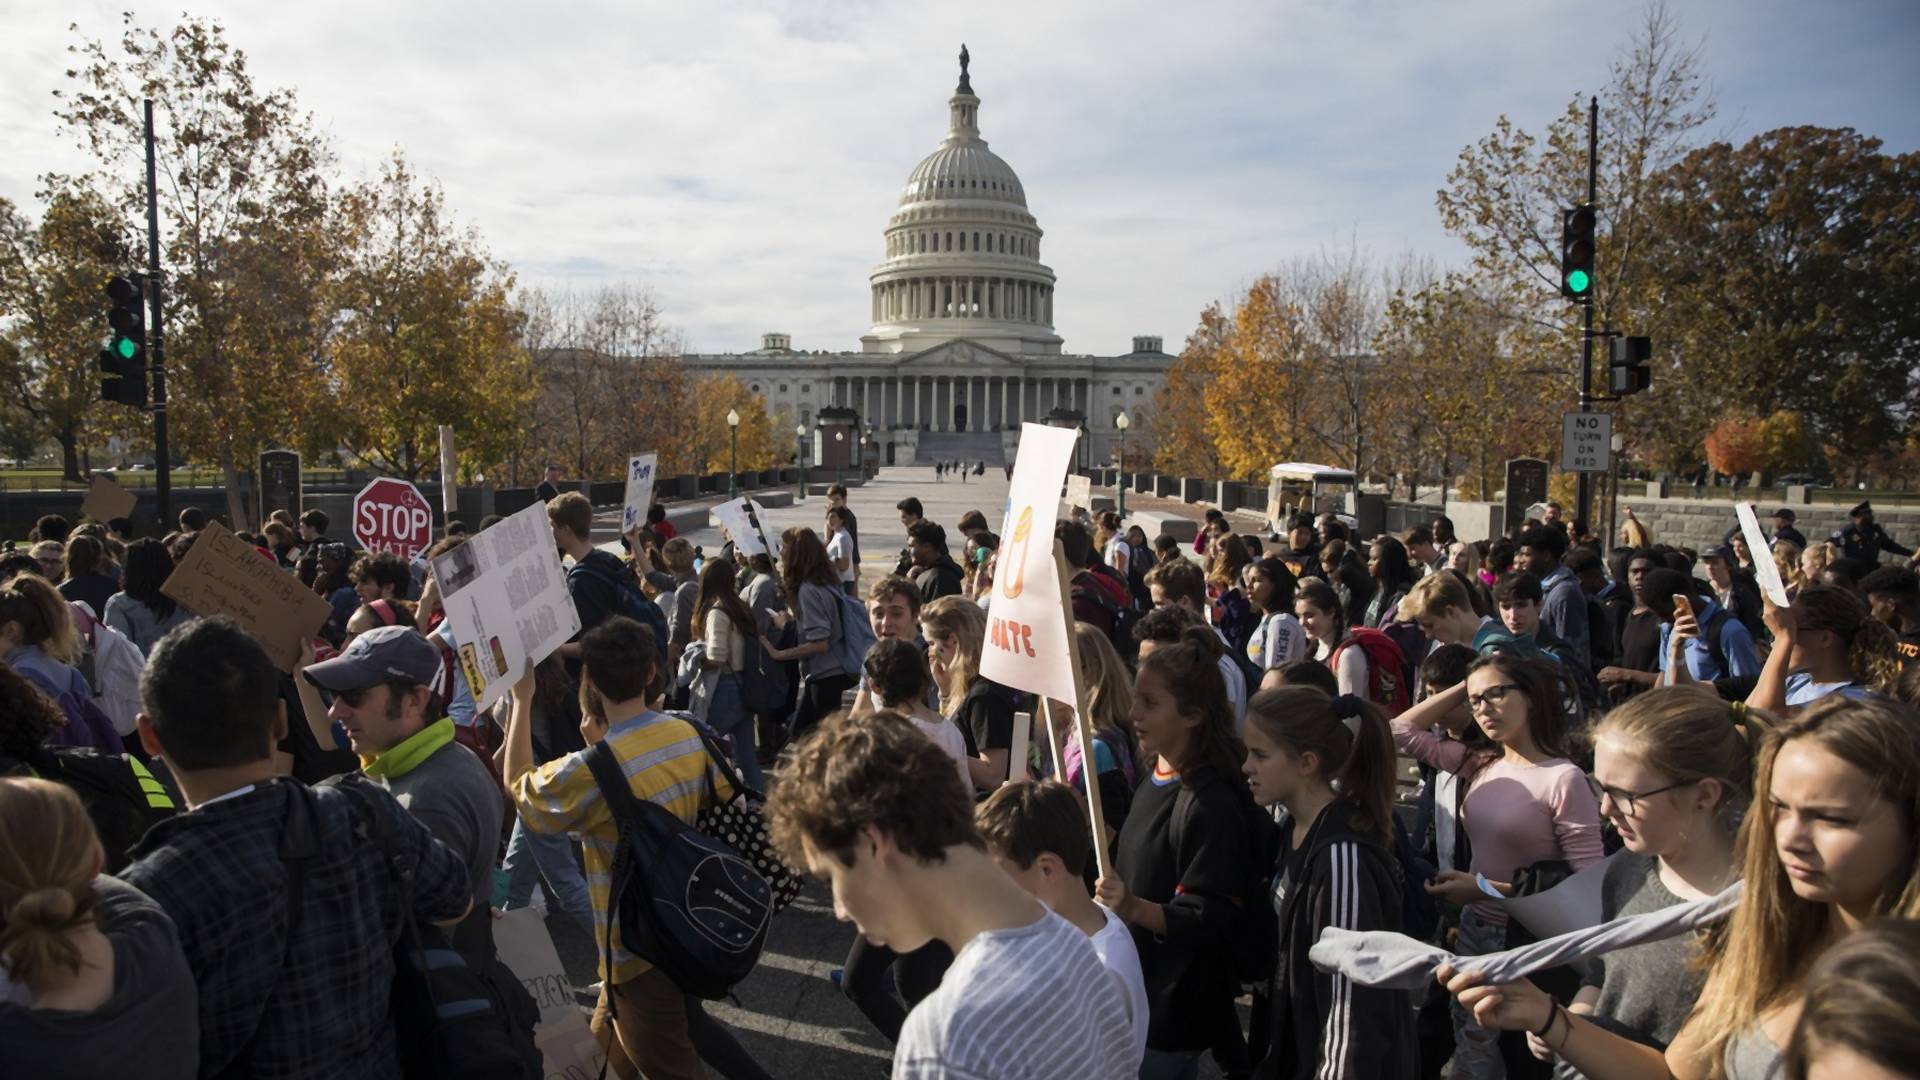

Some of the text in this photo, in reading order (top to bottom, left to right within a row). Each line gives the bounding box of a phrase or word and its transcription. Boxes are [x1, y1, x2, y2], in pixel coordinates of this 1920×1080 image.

[1576, 417, 1599, 429] NO
[1573, 431, 1602, 442] TURN
[1578, 445, 1595, 454] ON
[1574, 457, 1597, 467] RED
[358, 500, 428, 541] STOP
[368, 538, 420, 561] HATE
[991, 616, 1037, 658] HATE
